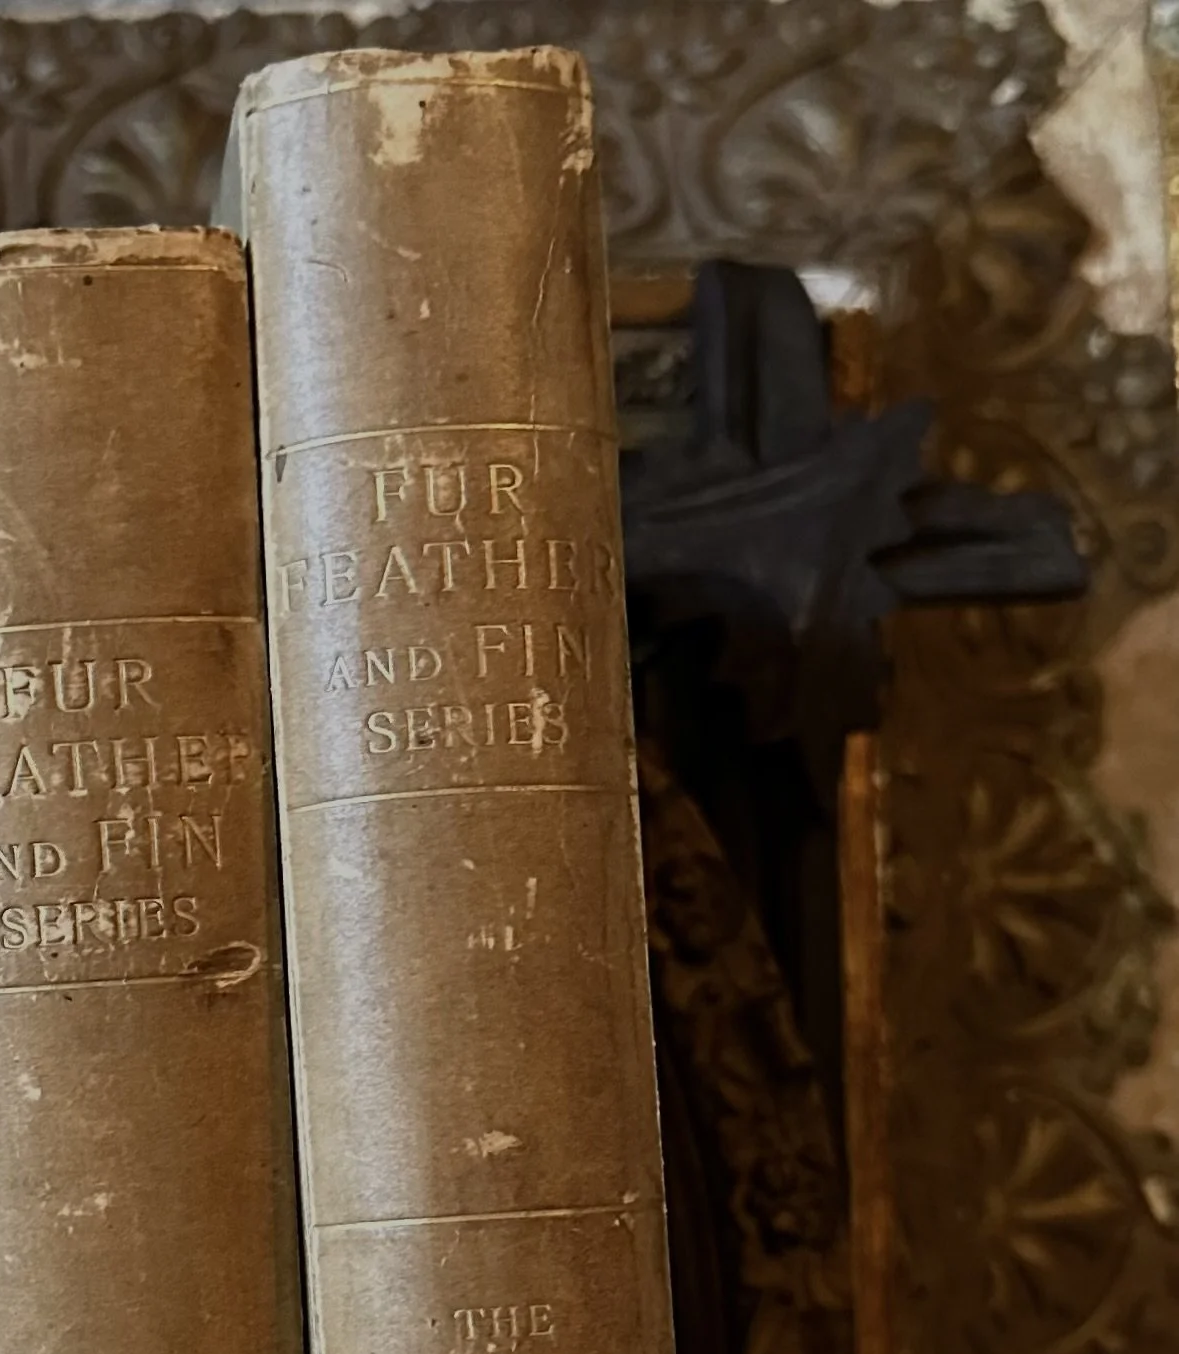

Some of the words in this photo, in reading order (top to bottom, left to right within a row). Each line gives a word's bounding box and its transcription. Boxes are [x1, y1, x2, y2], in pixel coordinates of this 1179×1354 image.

[373, 464, 526, 522] FUR
[275, 538, 619, 614] FEATHER
[325, 646, 442, 692] AND
[474, 624, 592, 682] FIN
[367, 702, 570, 754] SERIES
[95, 814, 222, 875] FIN
[0, 896, 200, 951] SERIES
[454, 1304, 555, 1341] THE
